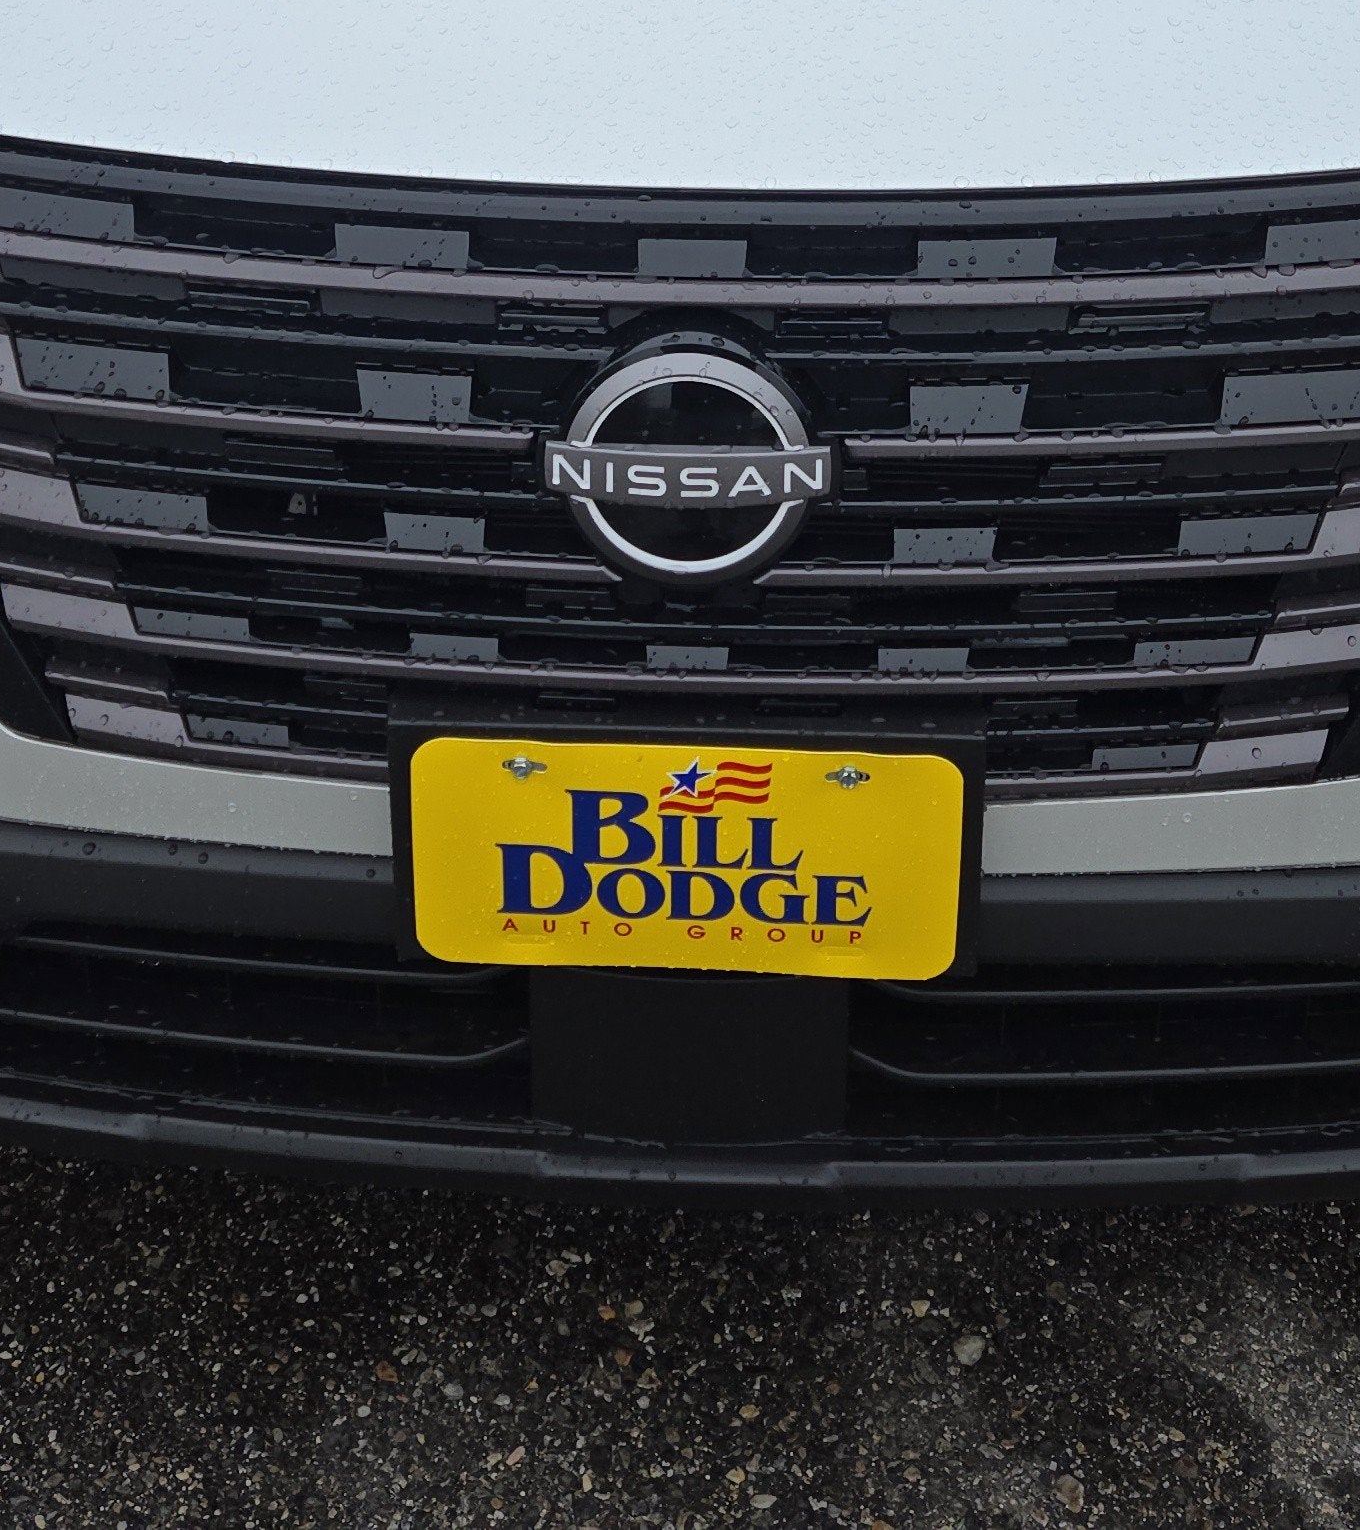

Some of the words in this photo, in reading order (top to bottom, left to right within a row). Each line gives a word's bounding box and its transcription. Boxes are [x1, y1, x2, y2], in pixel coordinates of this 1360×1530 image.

[551, 454, 823, 498] NISSAN
[565, 789, 803, 871] BILL
[495, 843, 872, 927] DODGE
[502, 918, 633, 937] AUTO
[686, 924, 862, 945] GROUP
